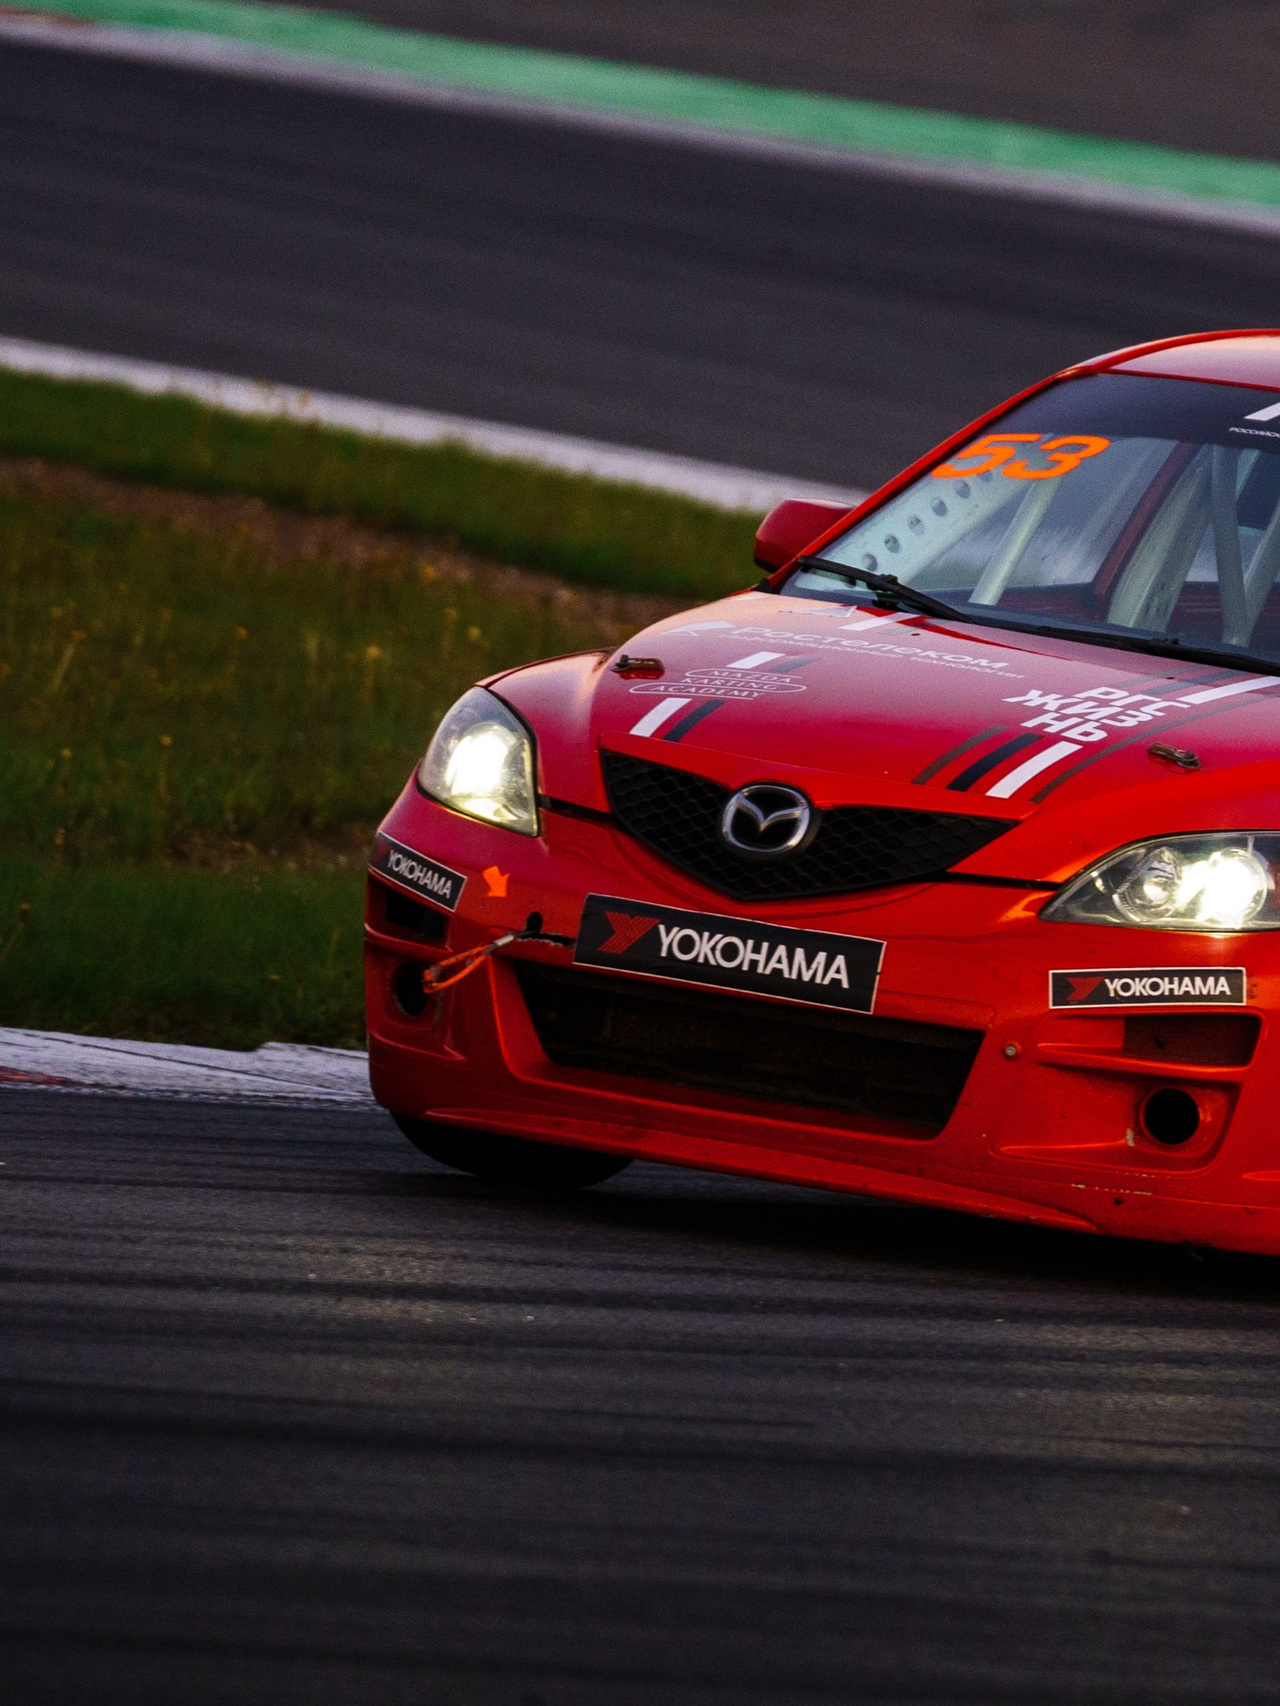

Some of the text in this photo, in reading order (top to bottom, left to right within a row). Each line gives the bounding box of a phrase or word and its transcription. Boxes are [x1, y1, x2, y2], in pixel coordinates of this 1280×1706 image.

[930, 433, 1111, 479] 53
[652, 685, 764, 698] ACADEMY
[682, 677, 779, 690] KARTING
[708, 670, 791, 684] MAZDA
[1001, 689, 1154, 727] ЖИЗ
[1072, 686, 1192, 716] РГС
[1020, 712, 1108, 742] НЬ
[385, 848, 453, 900] YOKOHAMA
[656, 923, 851, 989] YOKOHAMA
[1103, 975, 1232, 998] YOKOHAMA
